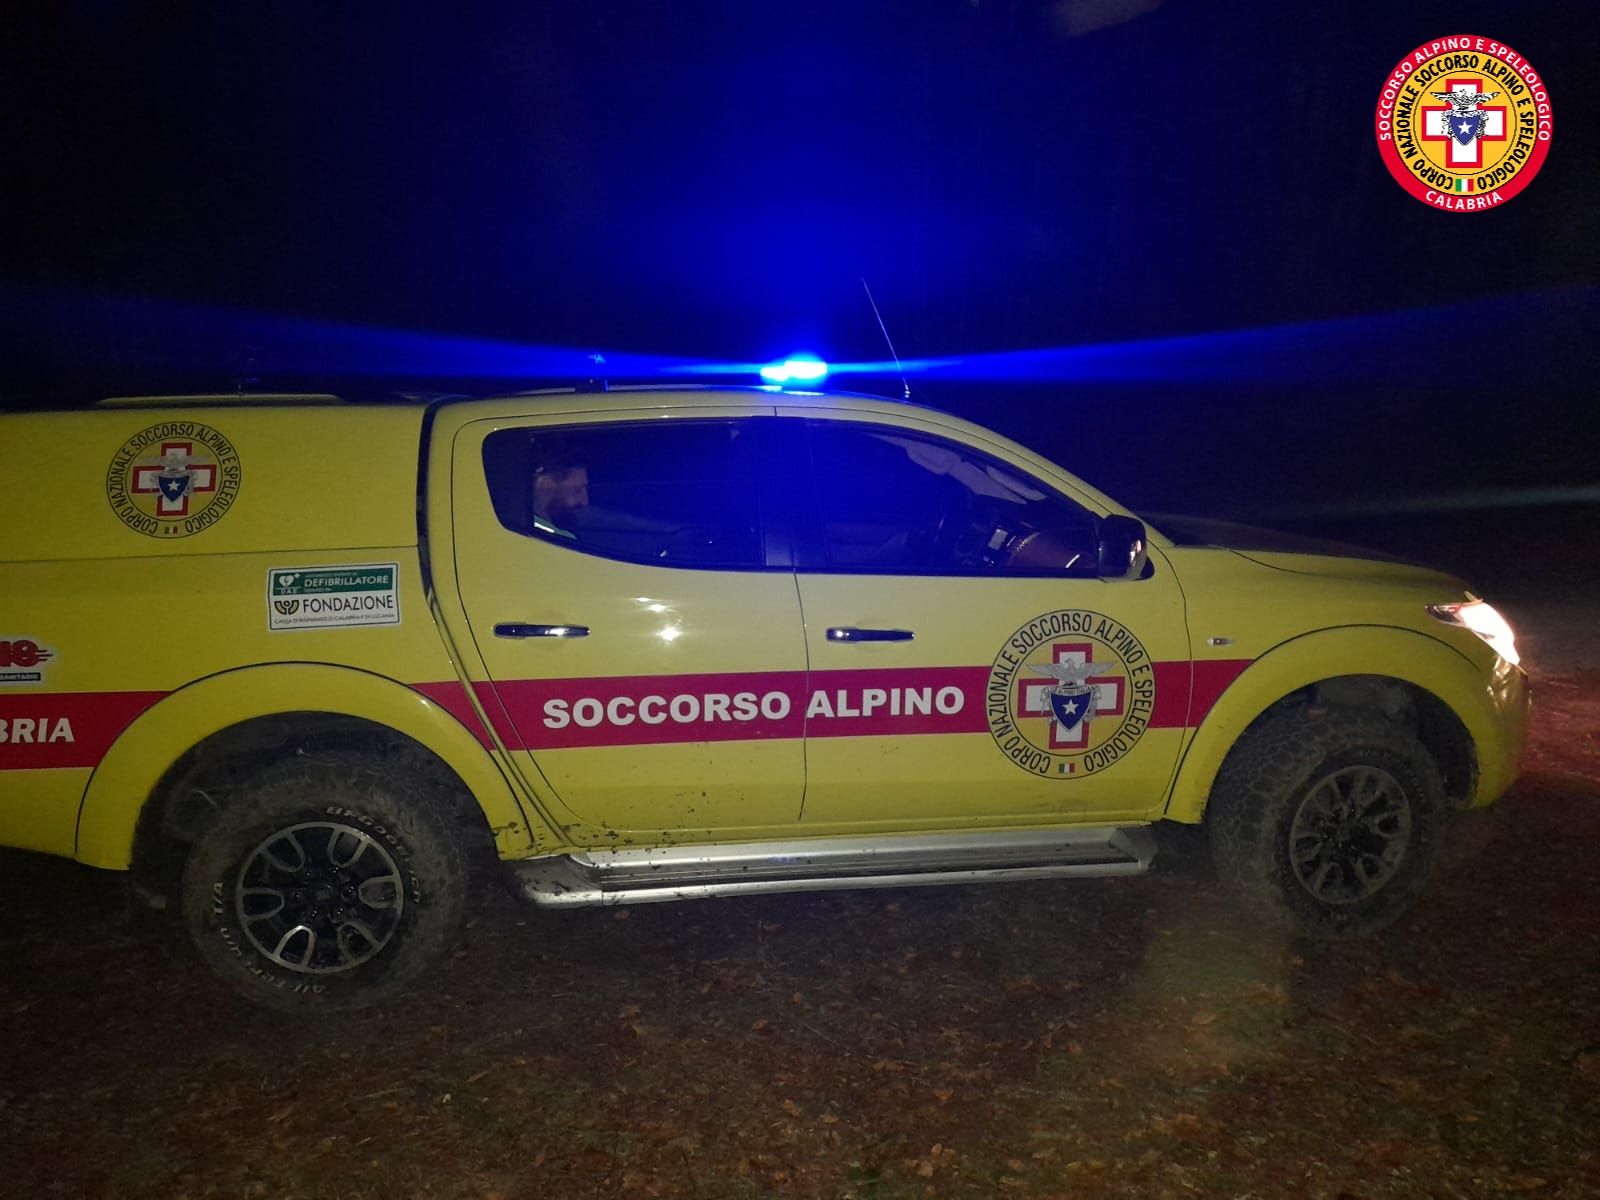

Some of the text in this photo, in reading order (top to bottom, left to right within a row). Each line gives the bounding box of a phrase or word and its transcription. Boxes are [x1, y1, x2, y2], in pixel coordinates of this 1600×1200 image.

[109, 423, 238, 535] CORPO NAZIONALE SOCCORSO ALPINO E SPELEOLOGICO
[304, 575, 389, 588] DEFIBRILLATORE
[303, 595, 393, 613] FONDAZIONE
[543, 686, 965, 729] SOCCORSO ALPINO
[988, 612, 1153, 774] CORPO NAZIONALE SOCCORSO ALPINO E SPELEOLOGICO
